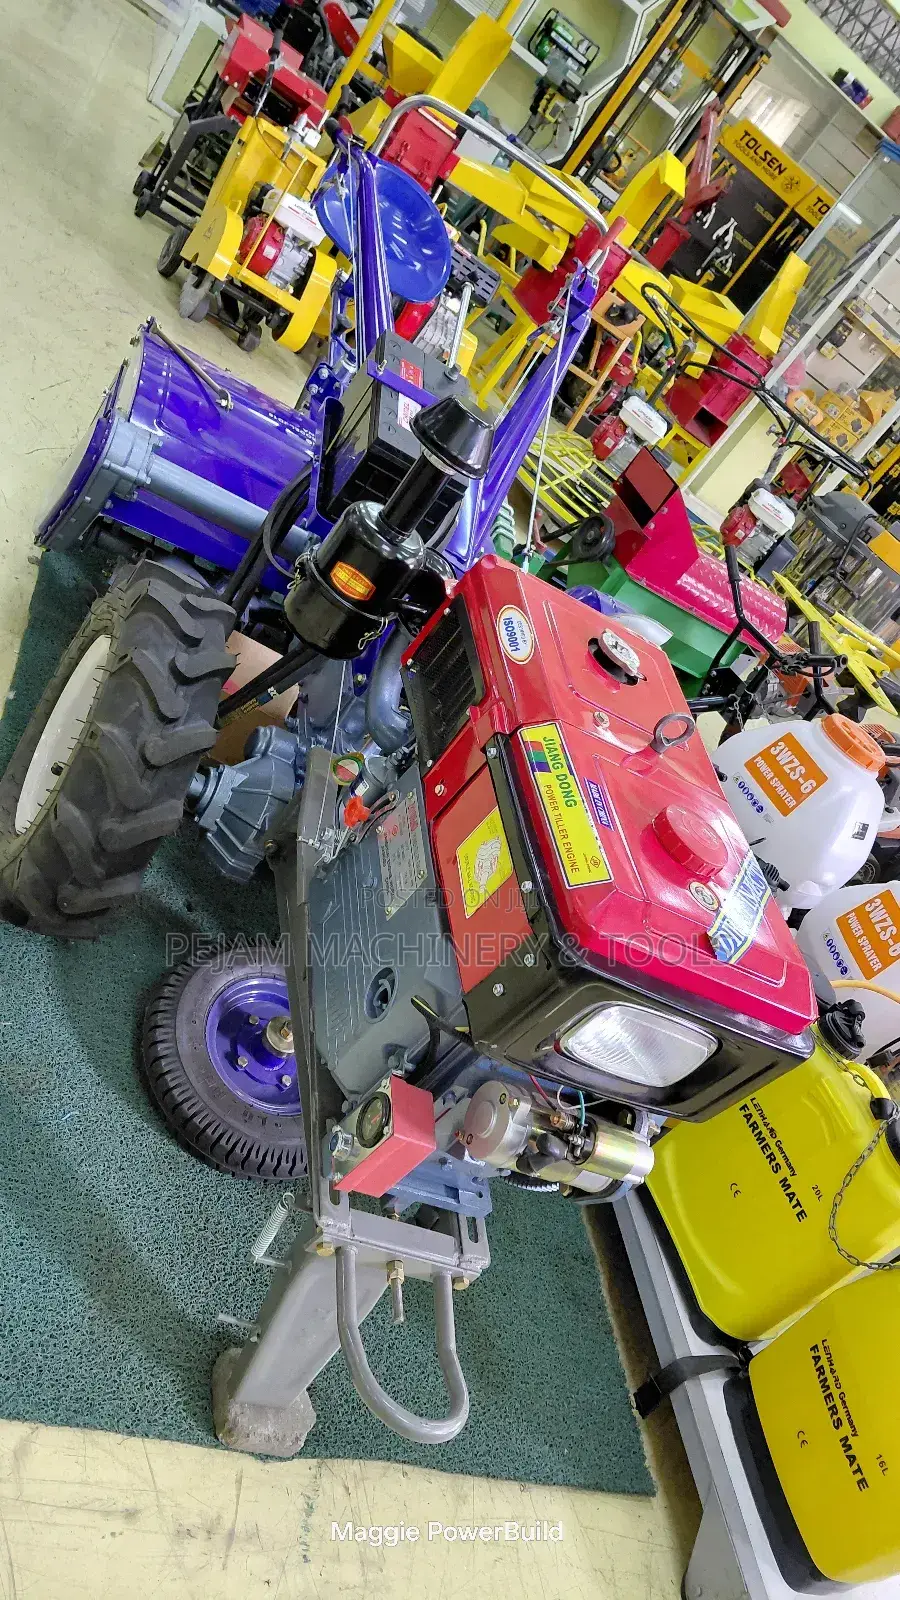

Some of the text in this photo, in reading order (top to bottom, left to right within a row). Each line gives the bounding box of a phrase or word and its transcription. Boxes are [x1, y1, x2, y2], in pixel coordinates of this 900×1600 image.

[740, 130, 787, 176] TOLSEN
[503, 617, 521, 652] ISO9001
[543, 736, 578, 808] JIANG DONG
[753, 756, 797, 809] POWER SPRAYER
[770, 741, 817, 794] 3WZS-6
[544, 784, 580, 873] POWER TILLER ENGINE
[846, 911, 883, 972] POWER SPRAYER
[739, 1103, 808, 1222] FARMERS MATE
[775, 1139, 798, 1178] Germany
[811, 1184, 825, 1202] 20L
[809, 1343, 870, 1492] FARMERS MATE
[838, 1391, 859, 1438] Germany
[875, 1453, 889, 1477] 16L
